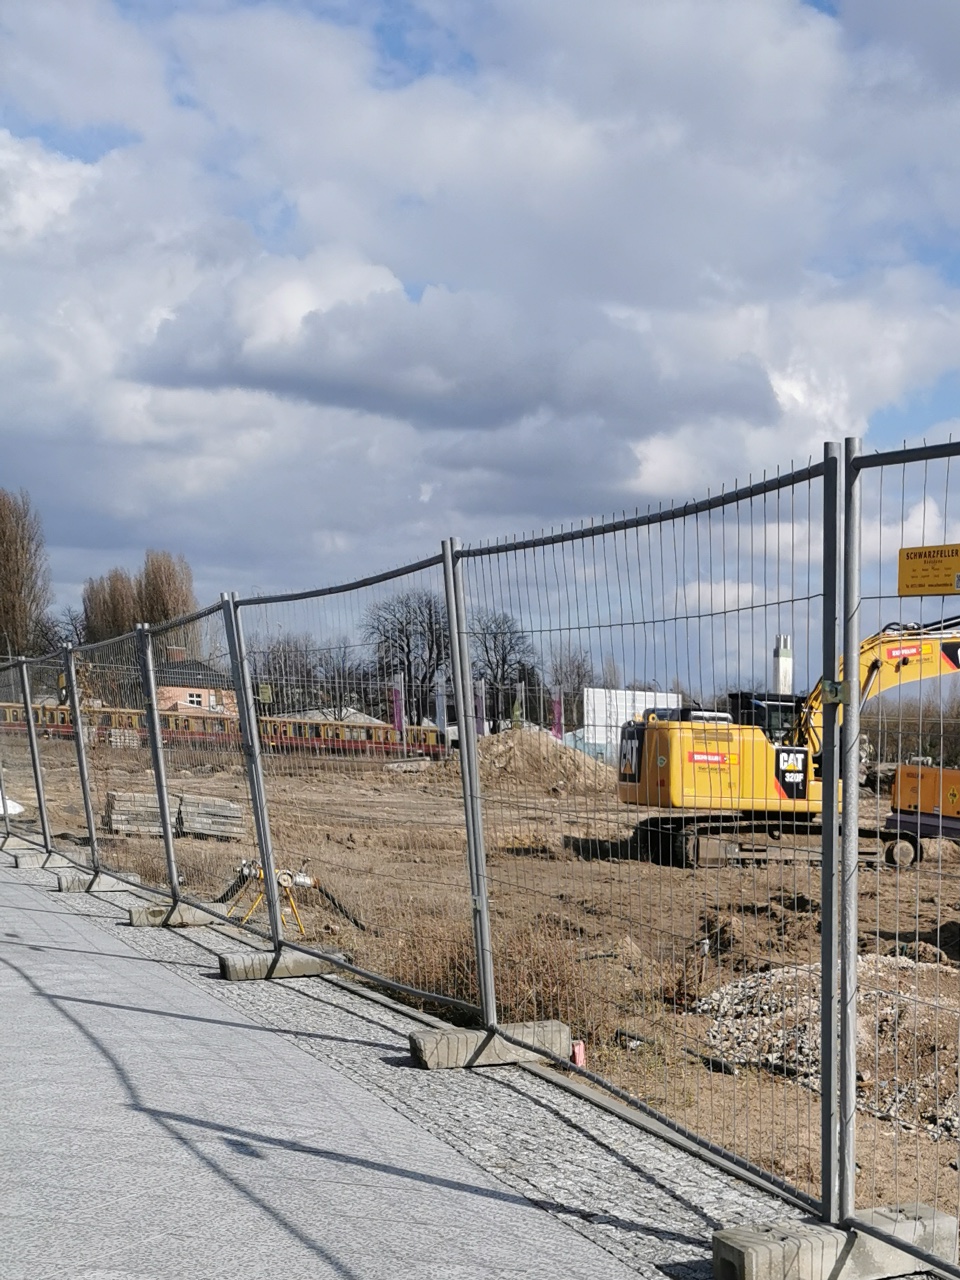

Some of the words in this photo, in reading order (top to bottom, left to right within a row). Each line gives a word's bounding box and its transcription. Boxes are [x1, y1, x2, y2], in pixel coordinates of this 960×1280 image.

[906, 549, 959, 560] SCHWARZFELLER
[620, 739, 639, 774] CAT
[779, 752, 805, 771] CAT
[784, 772, 804, 782] 320F
